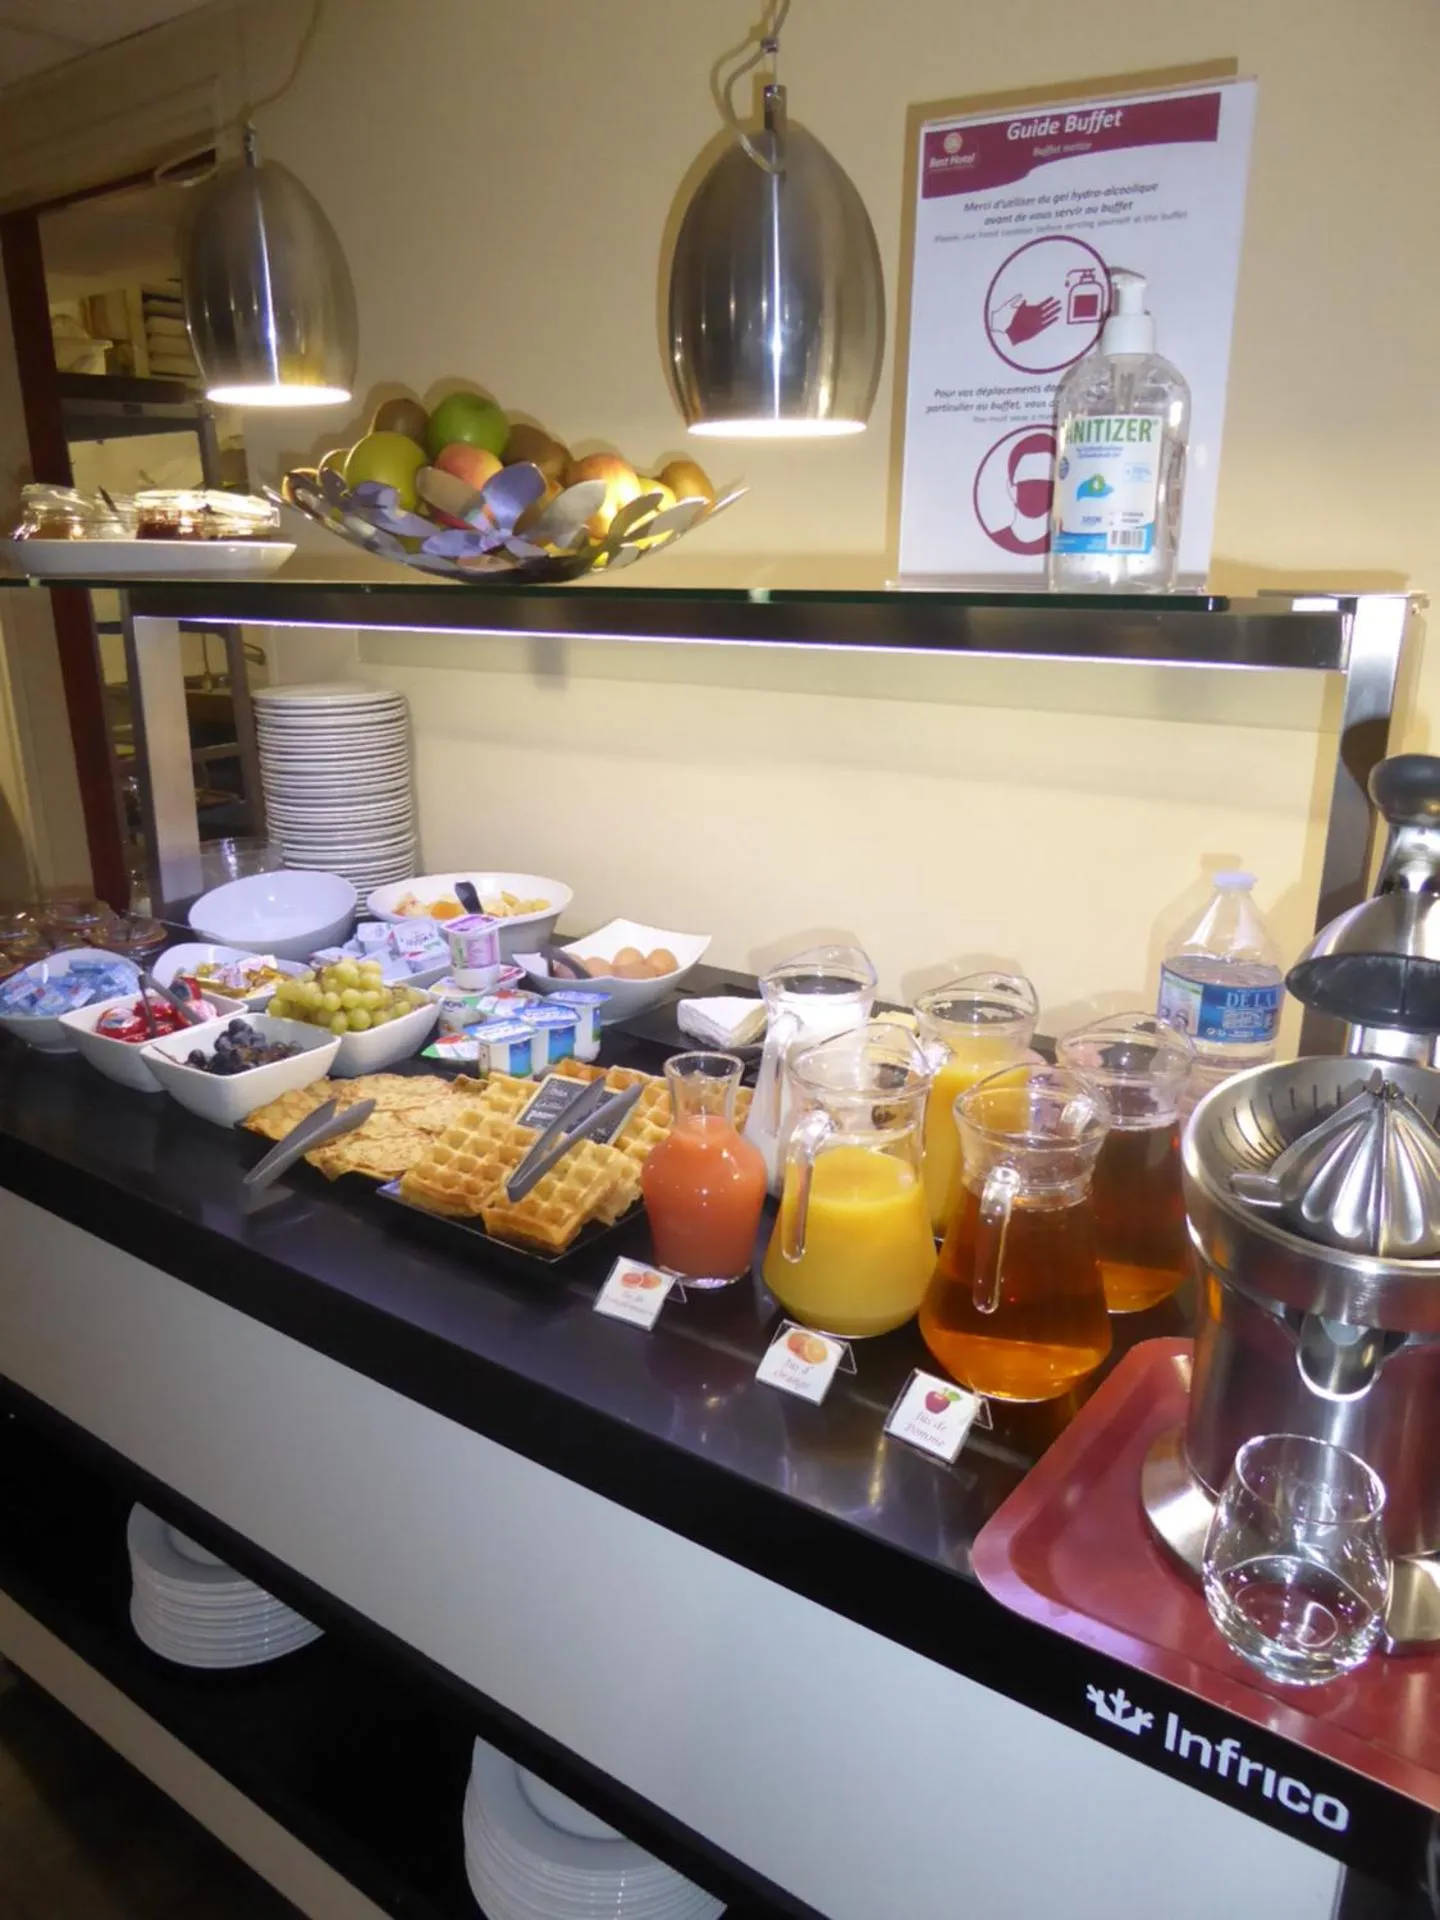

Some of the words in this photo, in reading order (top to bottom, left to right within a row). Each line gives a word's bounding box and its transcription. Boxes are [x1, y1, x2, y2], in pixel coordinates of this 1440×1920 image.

[1006, 118, 1060, 141] Guide
[1064, 109, 1124, 135] Buffet
[963, 202, 992, 212] Merci
[1038, 194, 1051, 204] du
[1053, 193, 1069, 205] gel
[984, 214, 1013, 226] avant
[1015, 213, 1027, 223] de
[1055, 208, 1082, 218] servir
[1085, 206, 1099, 214] au
[1101, 200, 1133, 214] buffet
[934, 388, 956, 398] Pour
[958, 389, 973, 397] vos
[976, 384, 1041, 397] déplacements
[925, 403, 974, 414] particulier
[976, 403, 989, 411] au
[1163, 1712, 1350, 1832] Infrico
